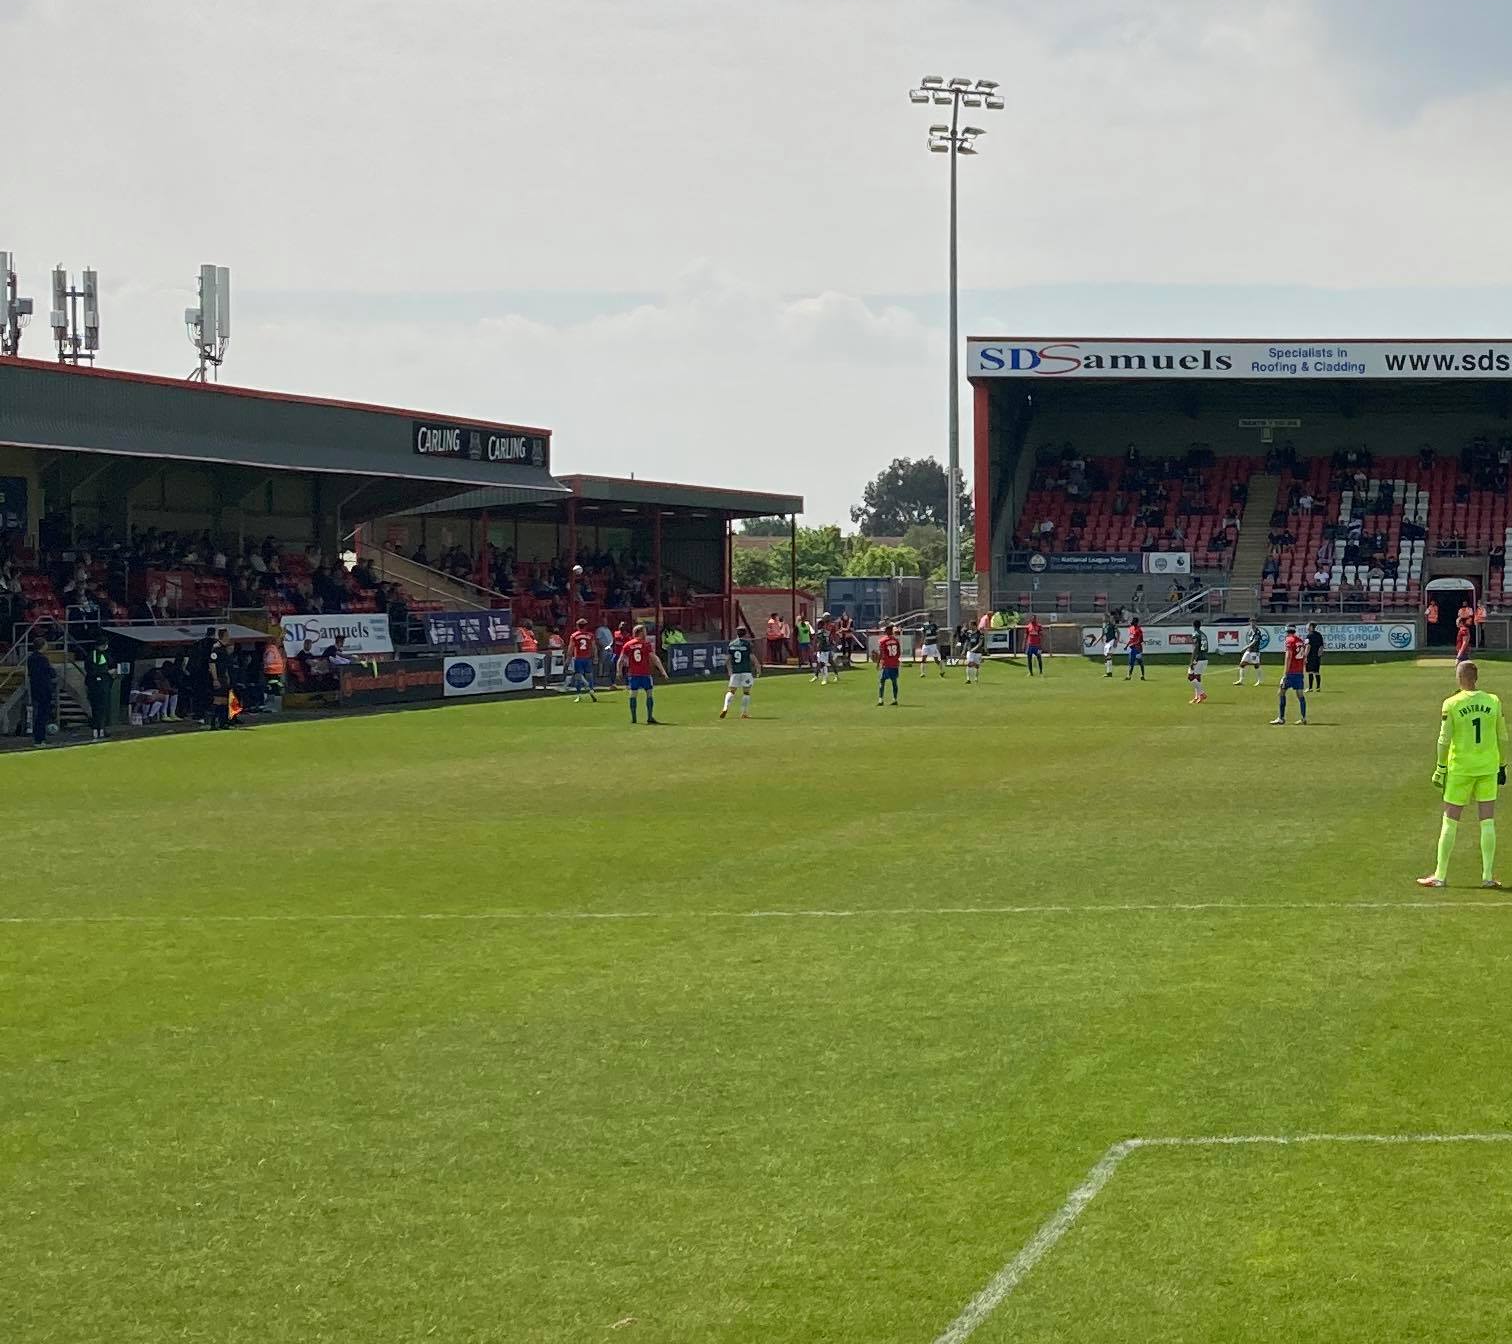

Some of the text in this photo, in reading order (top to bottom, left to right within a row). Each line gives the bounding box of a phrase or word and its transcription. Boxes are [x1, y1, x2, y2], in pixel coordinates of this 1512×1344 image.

[1268, 347, 1348, 359] Specialists in
[1251, 360, 1366, 374] Roofing & Cladding
[417, 426, 460, 453] CARLING
[488, 436, 526, 461] CARLING
[1088, 556, 1110, 564] League
[579, 639, 587, 650] 2
[633, 649, 642, 662] 6
[734, 650, 742, 664] 9
[1471, 717, 1481, 744] 1
